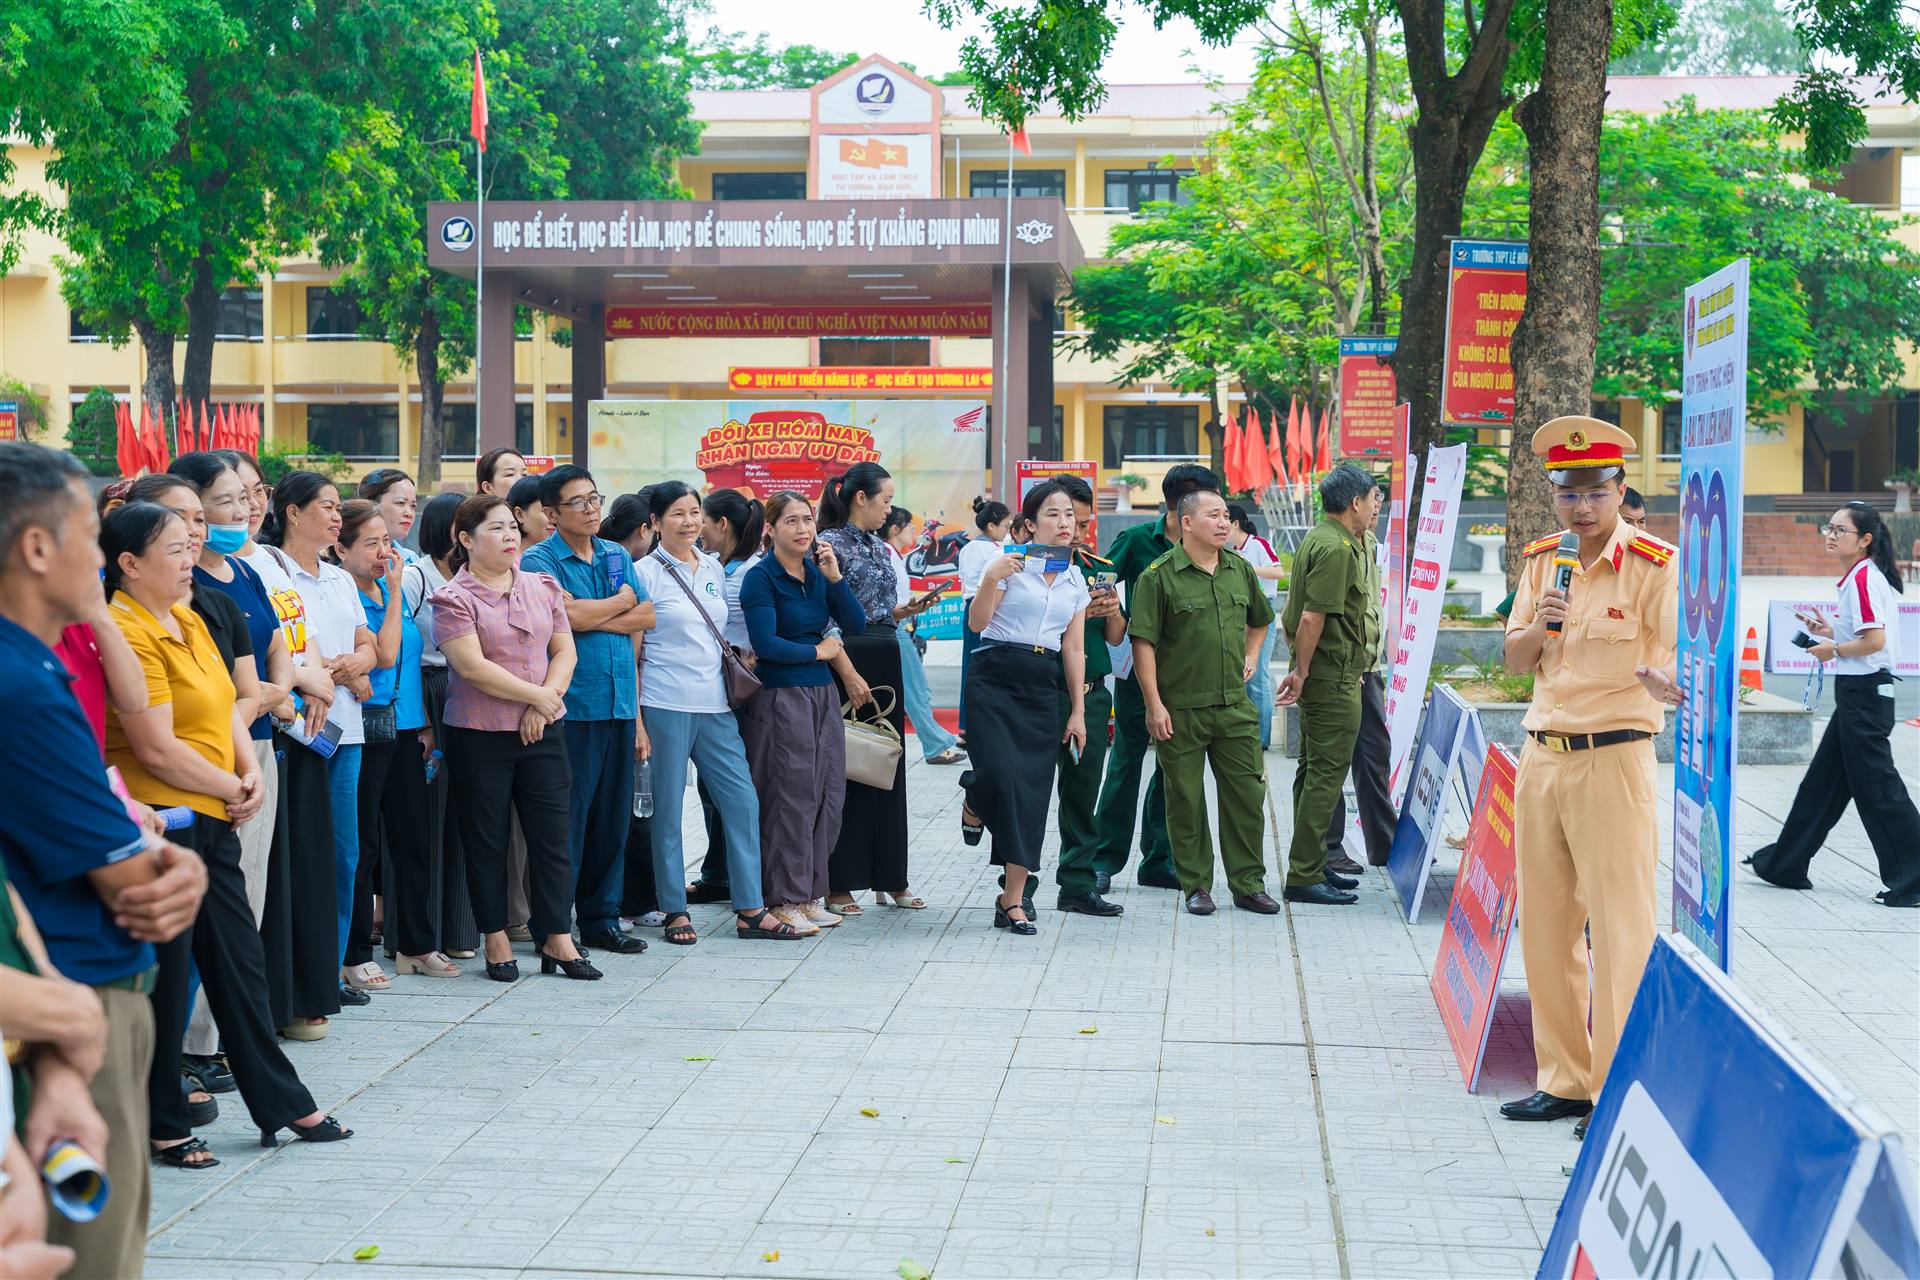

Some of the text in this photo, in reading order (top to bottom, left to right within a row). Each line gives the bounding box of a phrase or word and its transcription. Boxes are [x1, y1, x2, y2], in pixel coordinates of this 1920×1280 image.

[494, 221, 520, 252] HỌC
[524, 210, 542, 248] ĐỂ
[579, 221, 606, 252] HỌC
[610, 210, 627, 248] ĐỂ
[664, 221, 691, 253] HỌC
[695, 210, 713, 248] ĐỂ
[715, 220, 761, 247] CHUNG
[807, 220, 833, 251] HỌC
[837, 208, 856, 246] ĐỂ
[858, 217, 877, 251] TỰ
[928, 219, 960, 250] ĐỊNH
[963, 213, 999, 245] MÌNH
[1495, 250, 1509, 264] THPT
[1509, 249, 1516, 264] LÊ
[640, 311, 988, 334] NƯỚC CỘNG HÒA XÃ HỘI CHỦ NGHĨA VIỆT NAM MUÔN NĂM
[1476, 316, 1501, 336] THÀNH
[1459, 342, 1485, 362] KHÔNG
[1486, 343, 1497, 362] CÓ
[1453, 364, 1468, 388] CỦA
[1470, 369, 1494, 389] NGƯỜI
[708, 418, 871, 446] ĐỔI XE HÔM NAY
[696, 443, 750, 469] NHẬN
[752, 441, 807, 459] NGAY
[808, 442, 838, 461] ƯU
